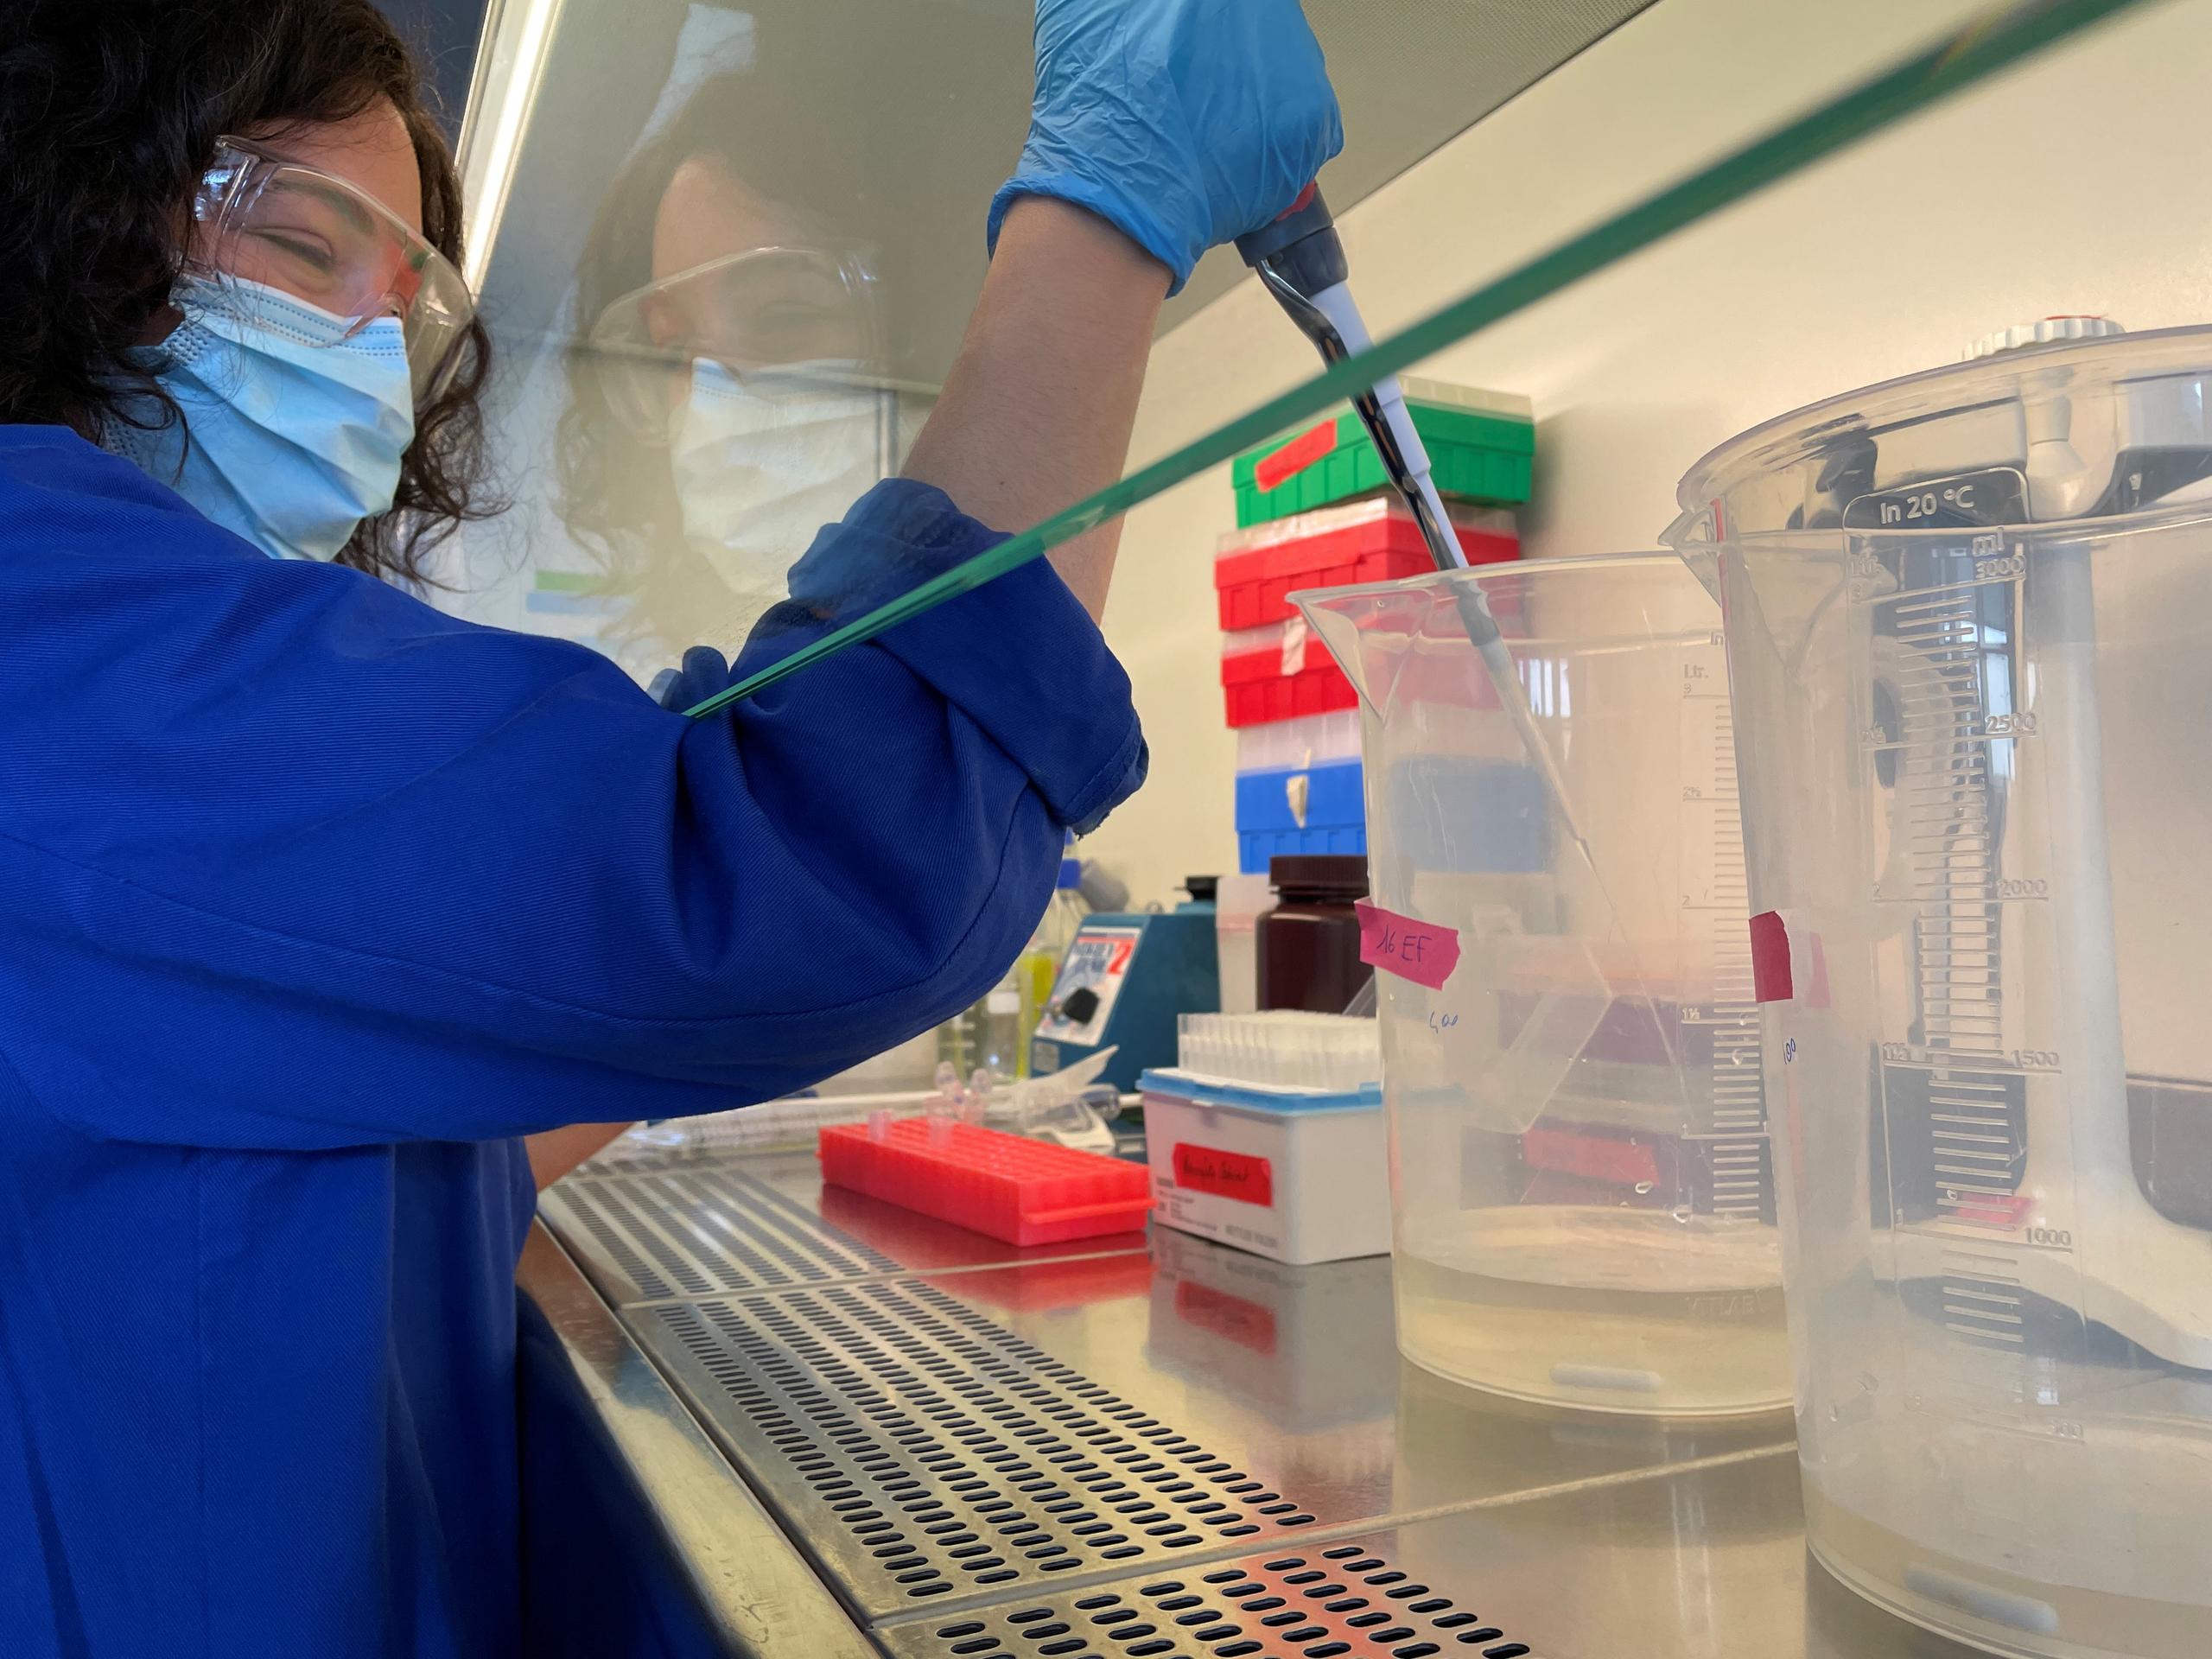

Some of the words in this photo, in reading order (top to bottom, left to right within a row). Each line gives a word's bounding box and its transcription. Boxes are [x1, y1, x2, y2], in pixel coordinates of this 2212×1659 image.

[1880, 502, 1901, 524] In
[1907, 493, 1937, 519] 20
[1944, 485, 1974, 508] °C
[1972, 525, 2005, 557] ml
[1975, 554, 2025, 579] 3000
[1986, 712, 2037, 734] 2500
[1997, 880, 2048, 896] 2000
[1681, 895, 1690, 906] 2
[1376, 924, 1396, 954] 16
[1401, 935, 1433, 963] EF
[2012, 1050, 2060, 1068] 1500
[2025, 1227, 2072, 1246] 1000
